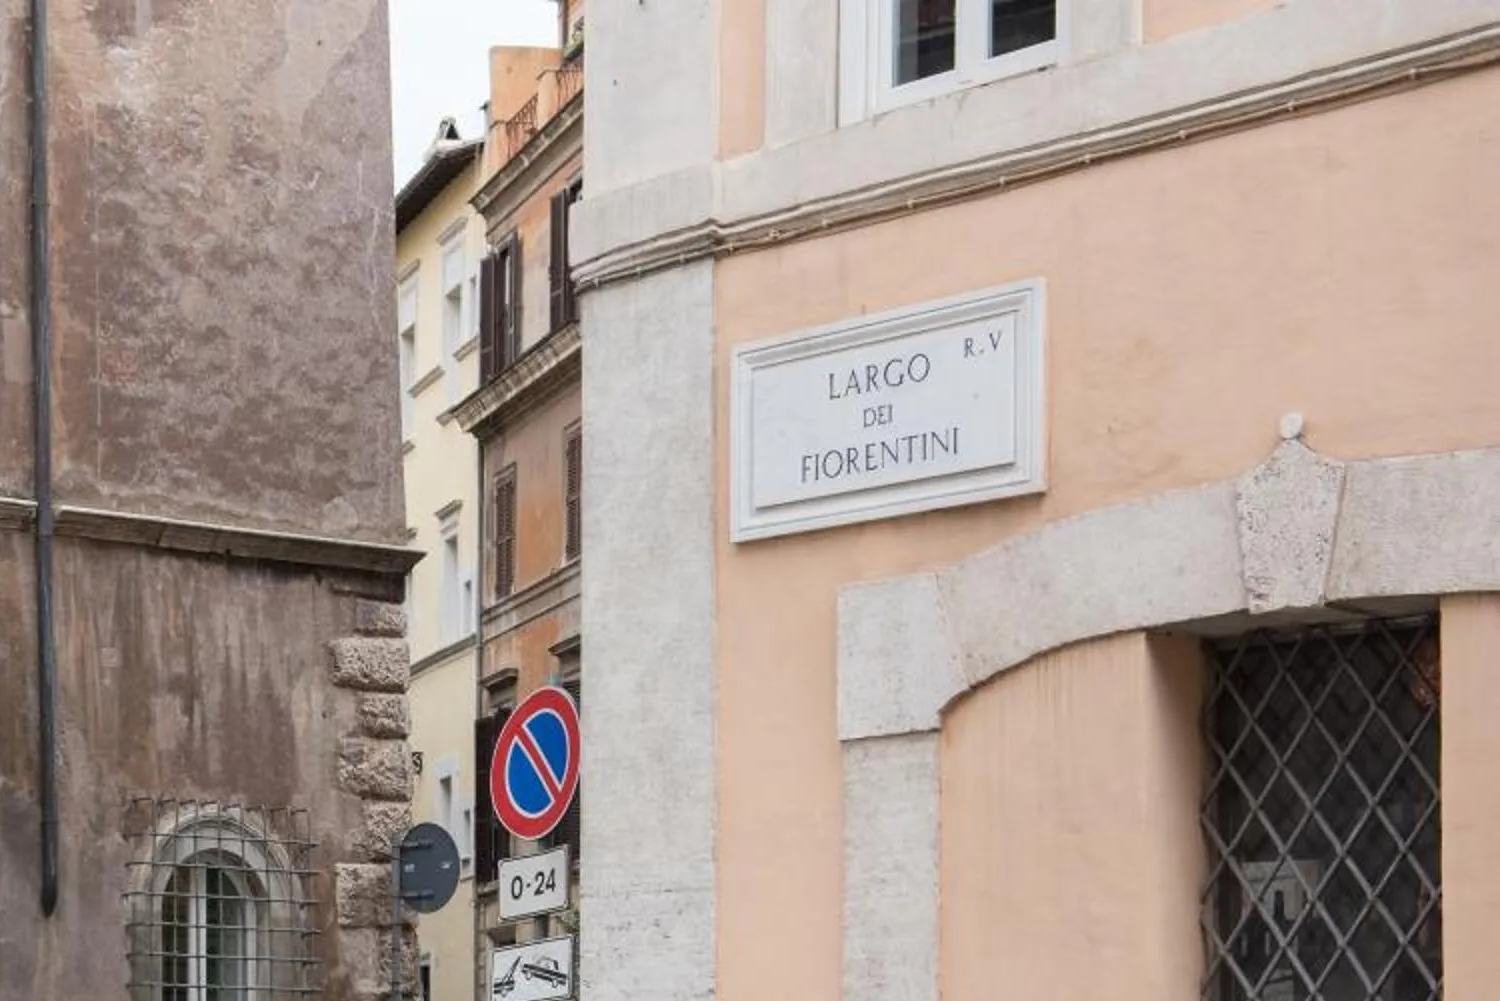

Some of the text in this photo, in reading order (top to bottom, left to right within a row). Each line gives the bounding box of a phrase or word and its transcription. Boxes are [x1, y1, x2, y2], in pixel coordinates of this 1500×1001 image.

[828, 353, 931, 400] LARGO
[863, 404, 894, 428] DEI
[801, 427, 961, 483] FIORENTINI
